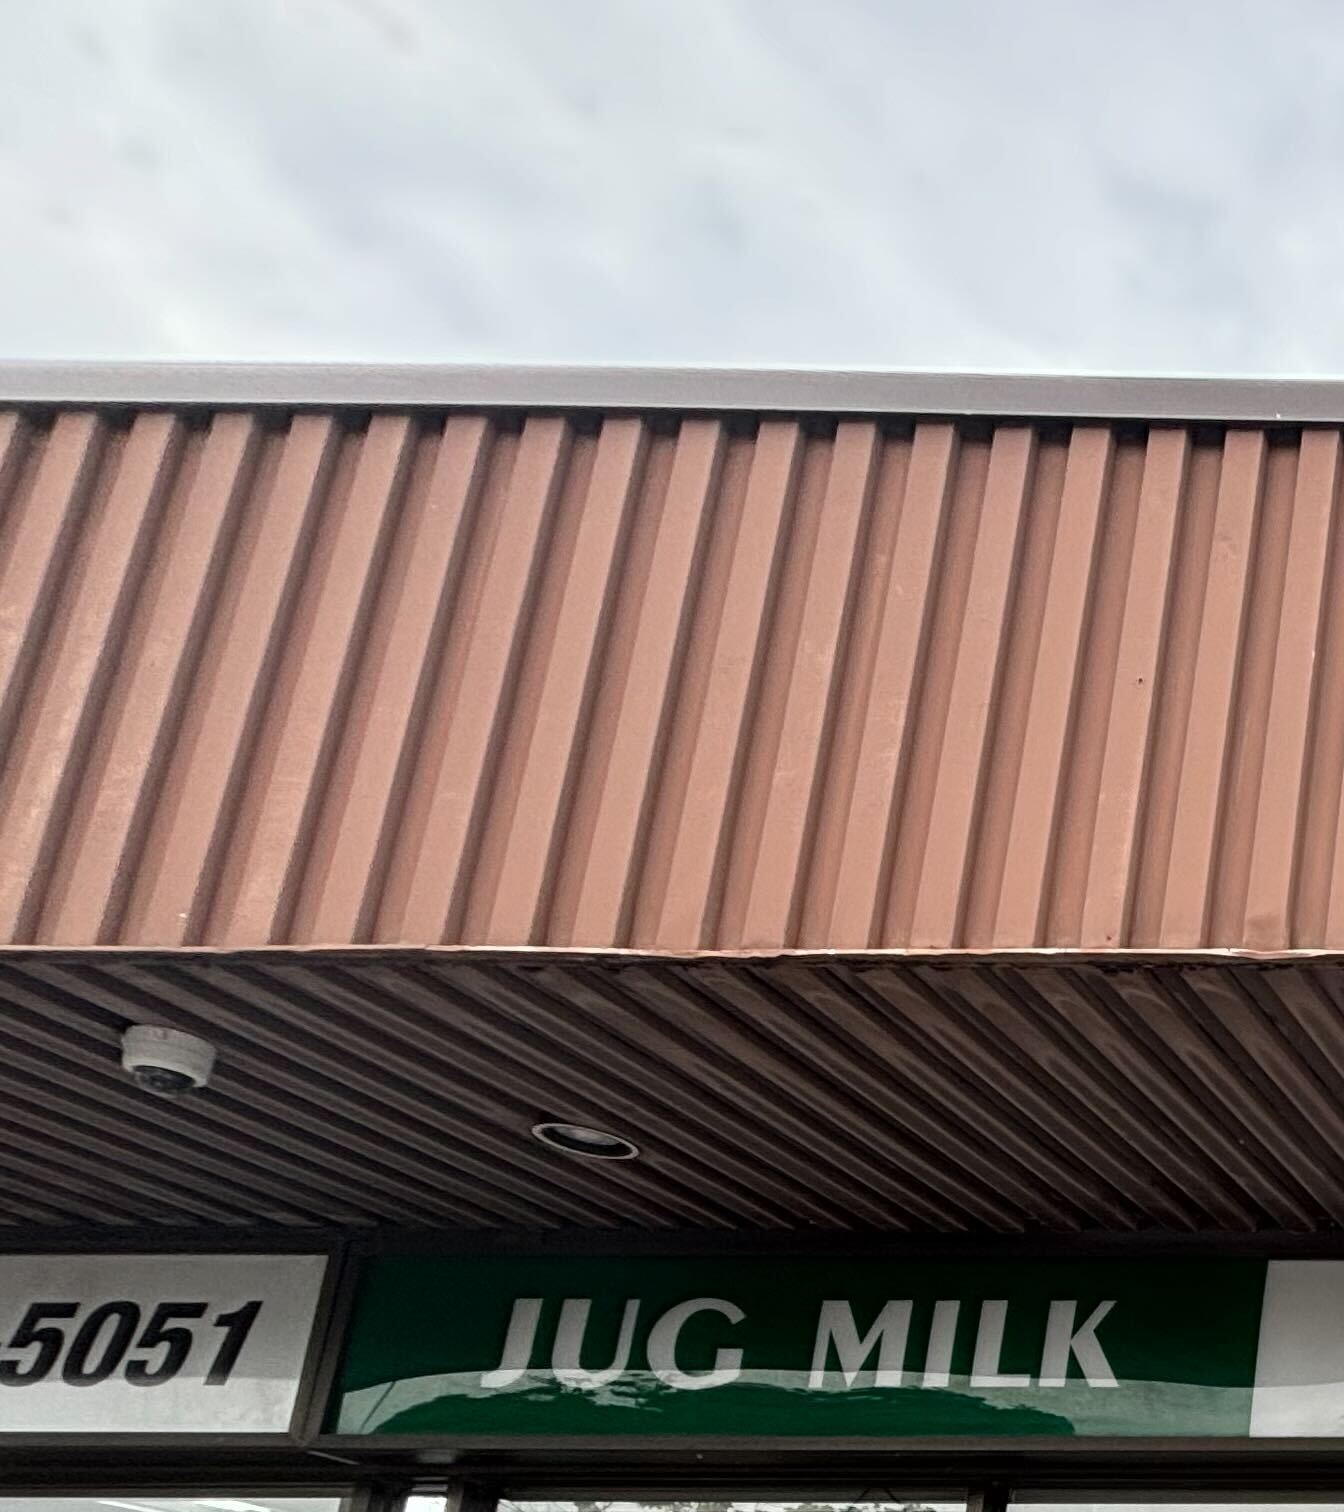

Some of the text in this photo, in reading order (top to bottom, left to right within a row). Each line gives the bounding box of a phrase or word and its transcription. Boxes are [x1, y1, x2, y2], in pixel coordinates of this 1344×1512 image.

[0, 1300, 264, 1388] 5051
[480, 1297, 1120, 1391] JUG MILK
